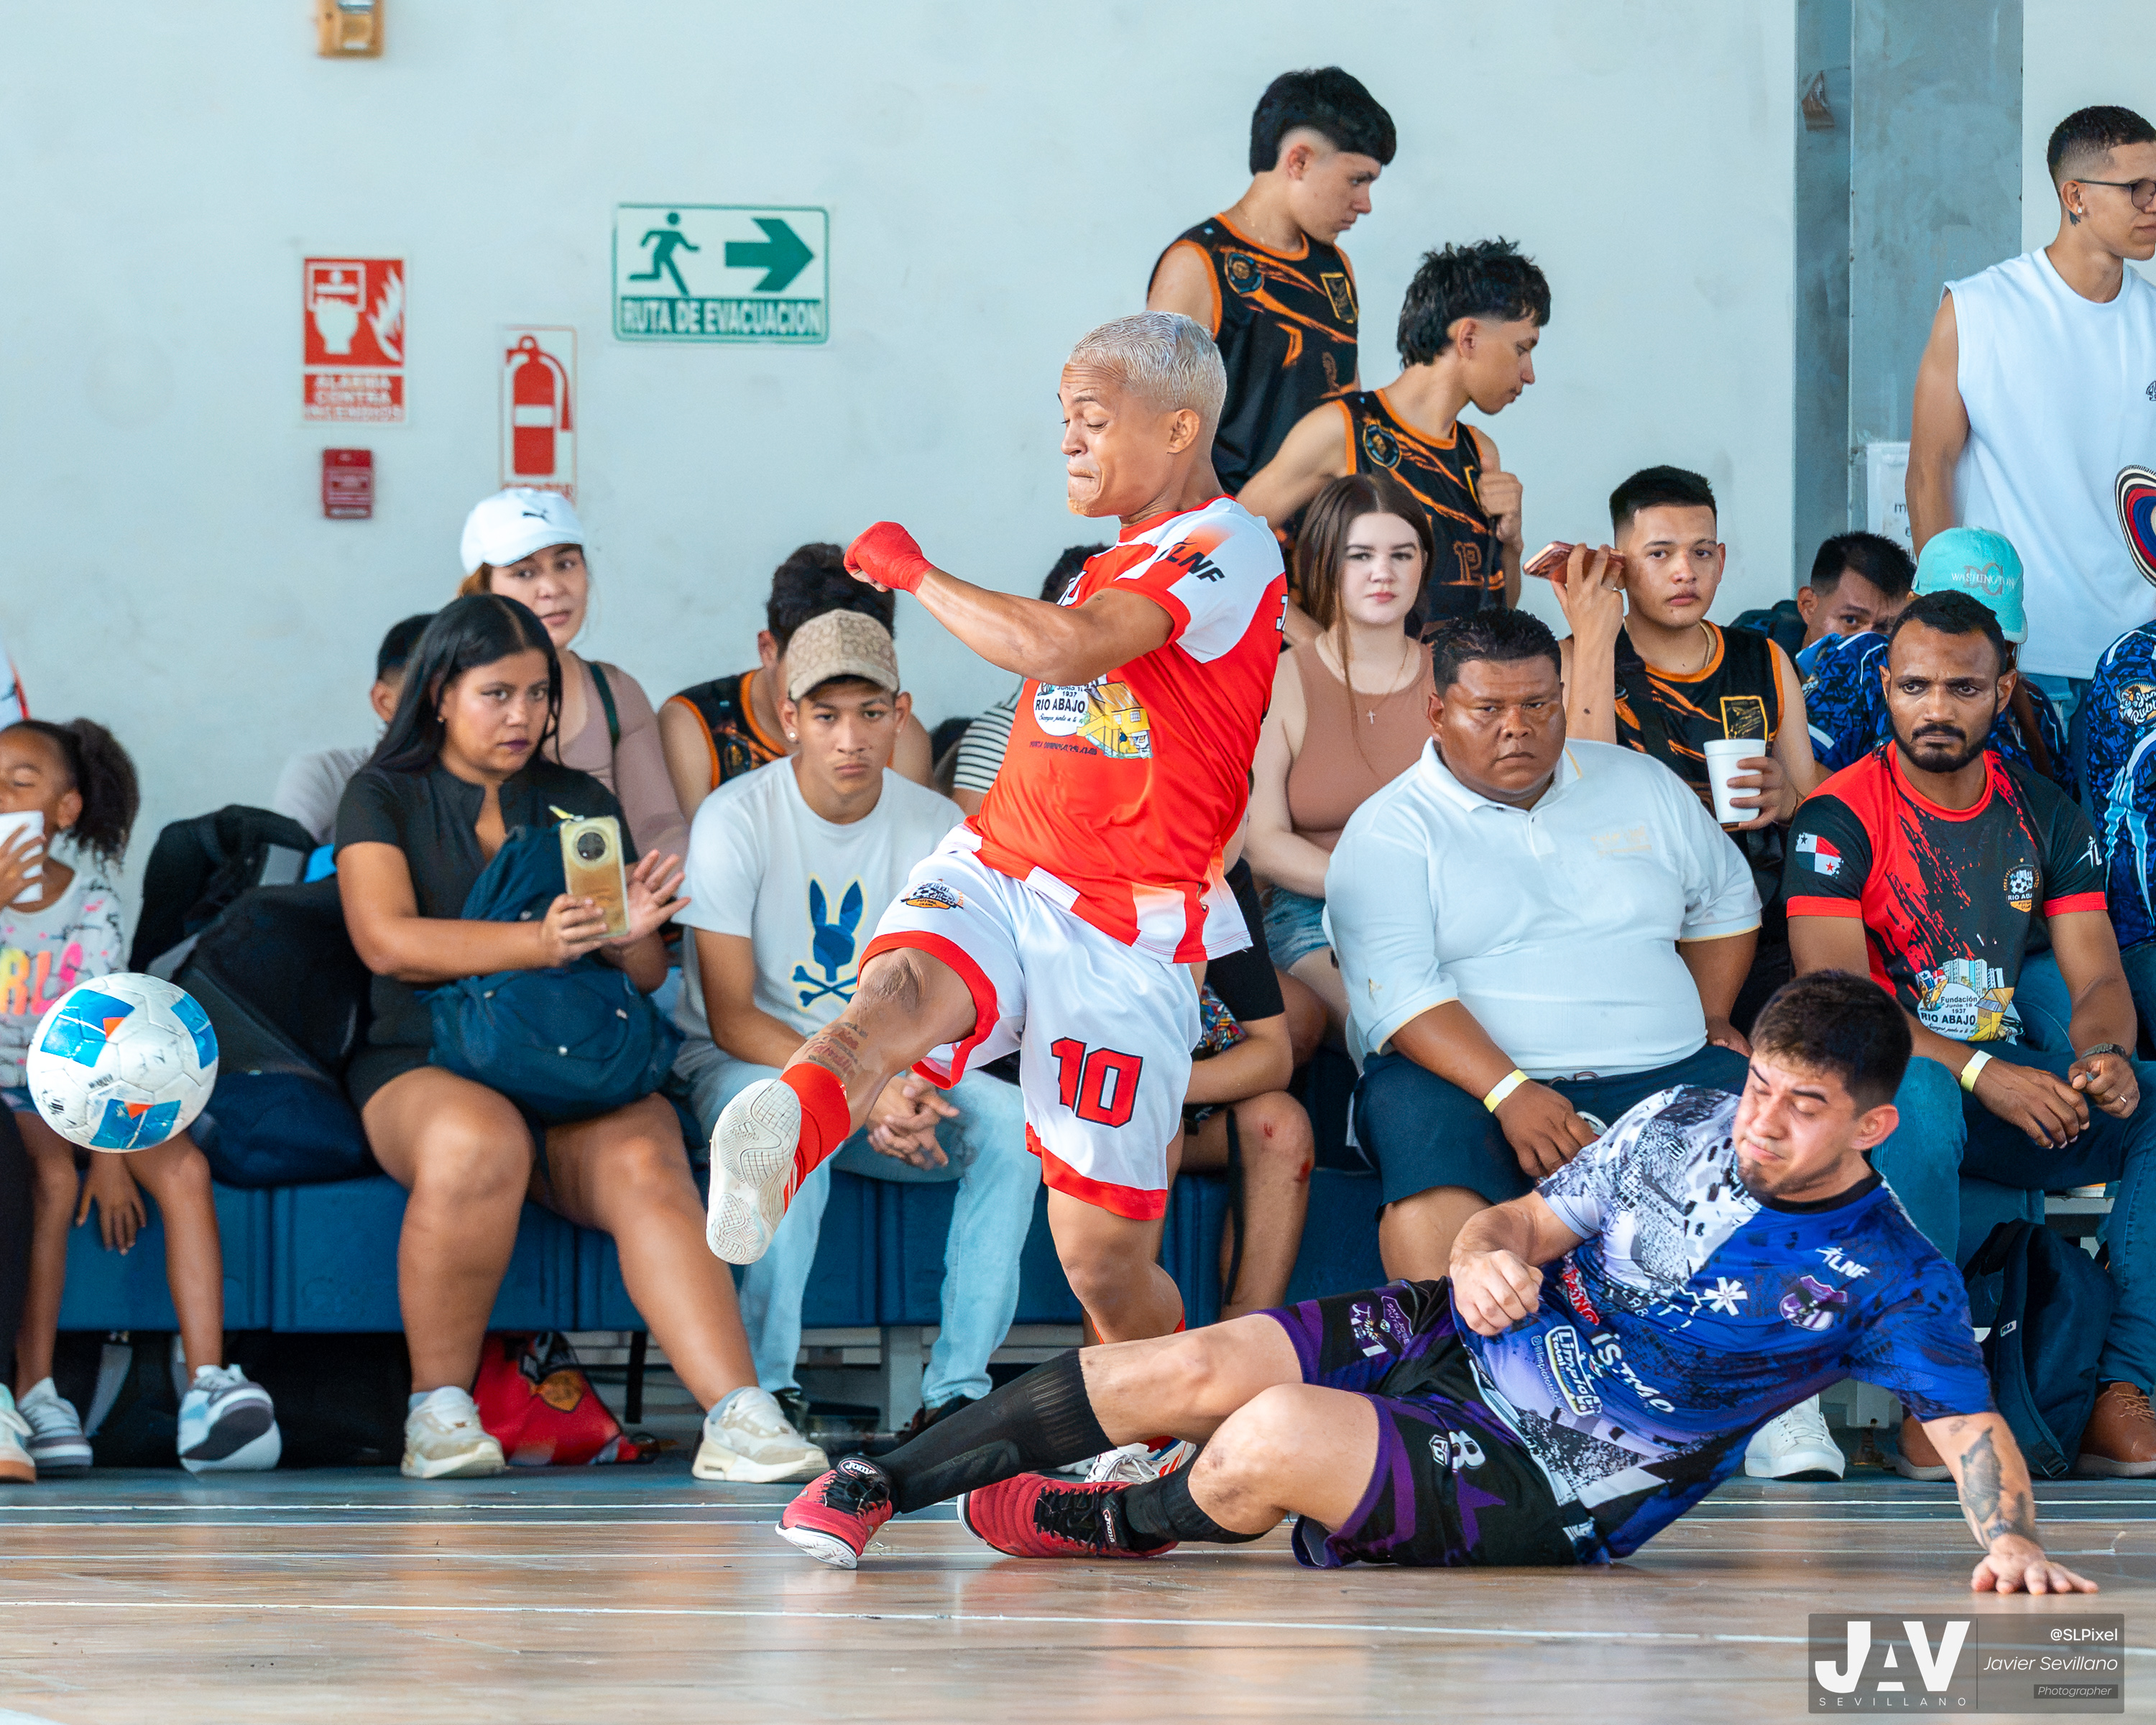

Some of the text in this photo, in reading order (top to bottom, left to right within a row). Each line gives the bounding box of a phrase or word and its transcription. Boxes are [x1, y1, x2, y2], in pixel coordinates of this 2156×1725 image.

[622, 300, 671, 332] RUTA
[676, 300, 701, 332] DE
[315, 392, 392, 403] CONTRA
[1951, 573, 2015, 589] WASHINGTON
[1035, 698, 1085, 713] RIO ABAJO
[1921, 1012, 1976, 1026] RIO ABAJO
[1050, 1036, 1143, 1128] 10
